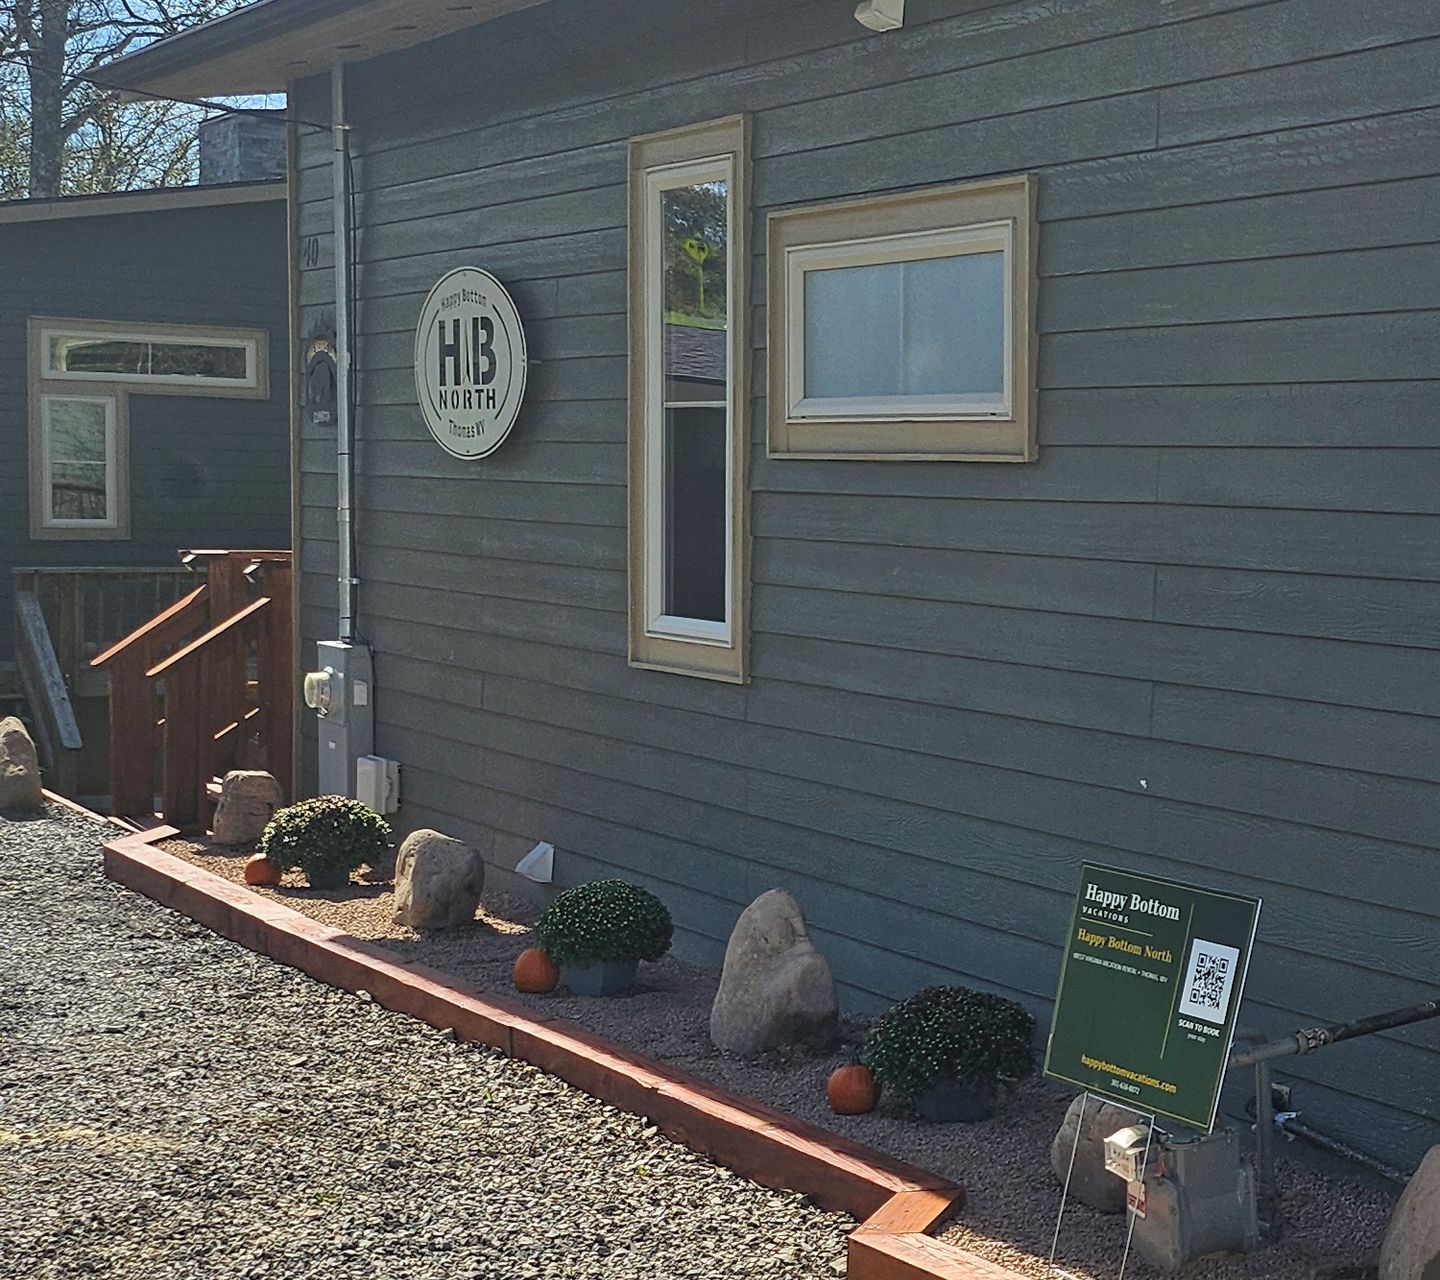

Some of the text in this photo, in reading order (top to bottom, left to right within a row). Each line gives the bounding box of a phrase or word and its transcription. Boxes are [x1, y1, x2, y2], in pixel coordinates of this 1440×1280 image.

[462, 288, 487, 308] Bottom
[439, 388, 497, 410] NORTH
[449, 419, 475, 438] Thomas
[1085, 883, 1180, 921] Happy Bottom
[1082, 906, 1129, 924] VACATIONS
[1077, 928, 1172, 964] Happy Bottom North
[1178, 1018, 1220, 1037] SCAN TO BOOK
[1081, 1053, 1177, 1094] happybottomvacations.com
